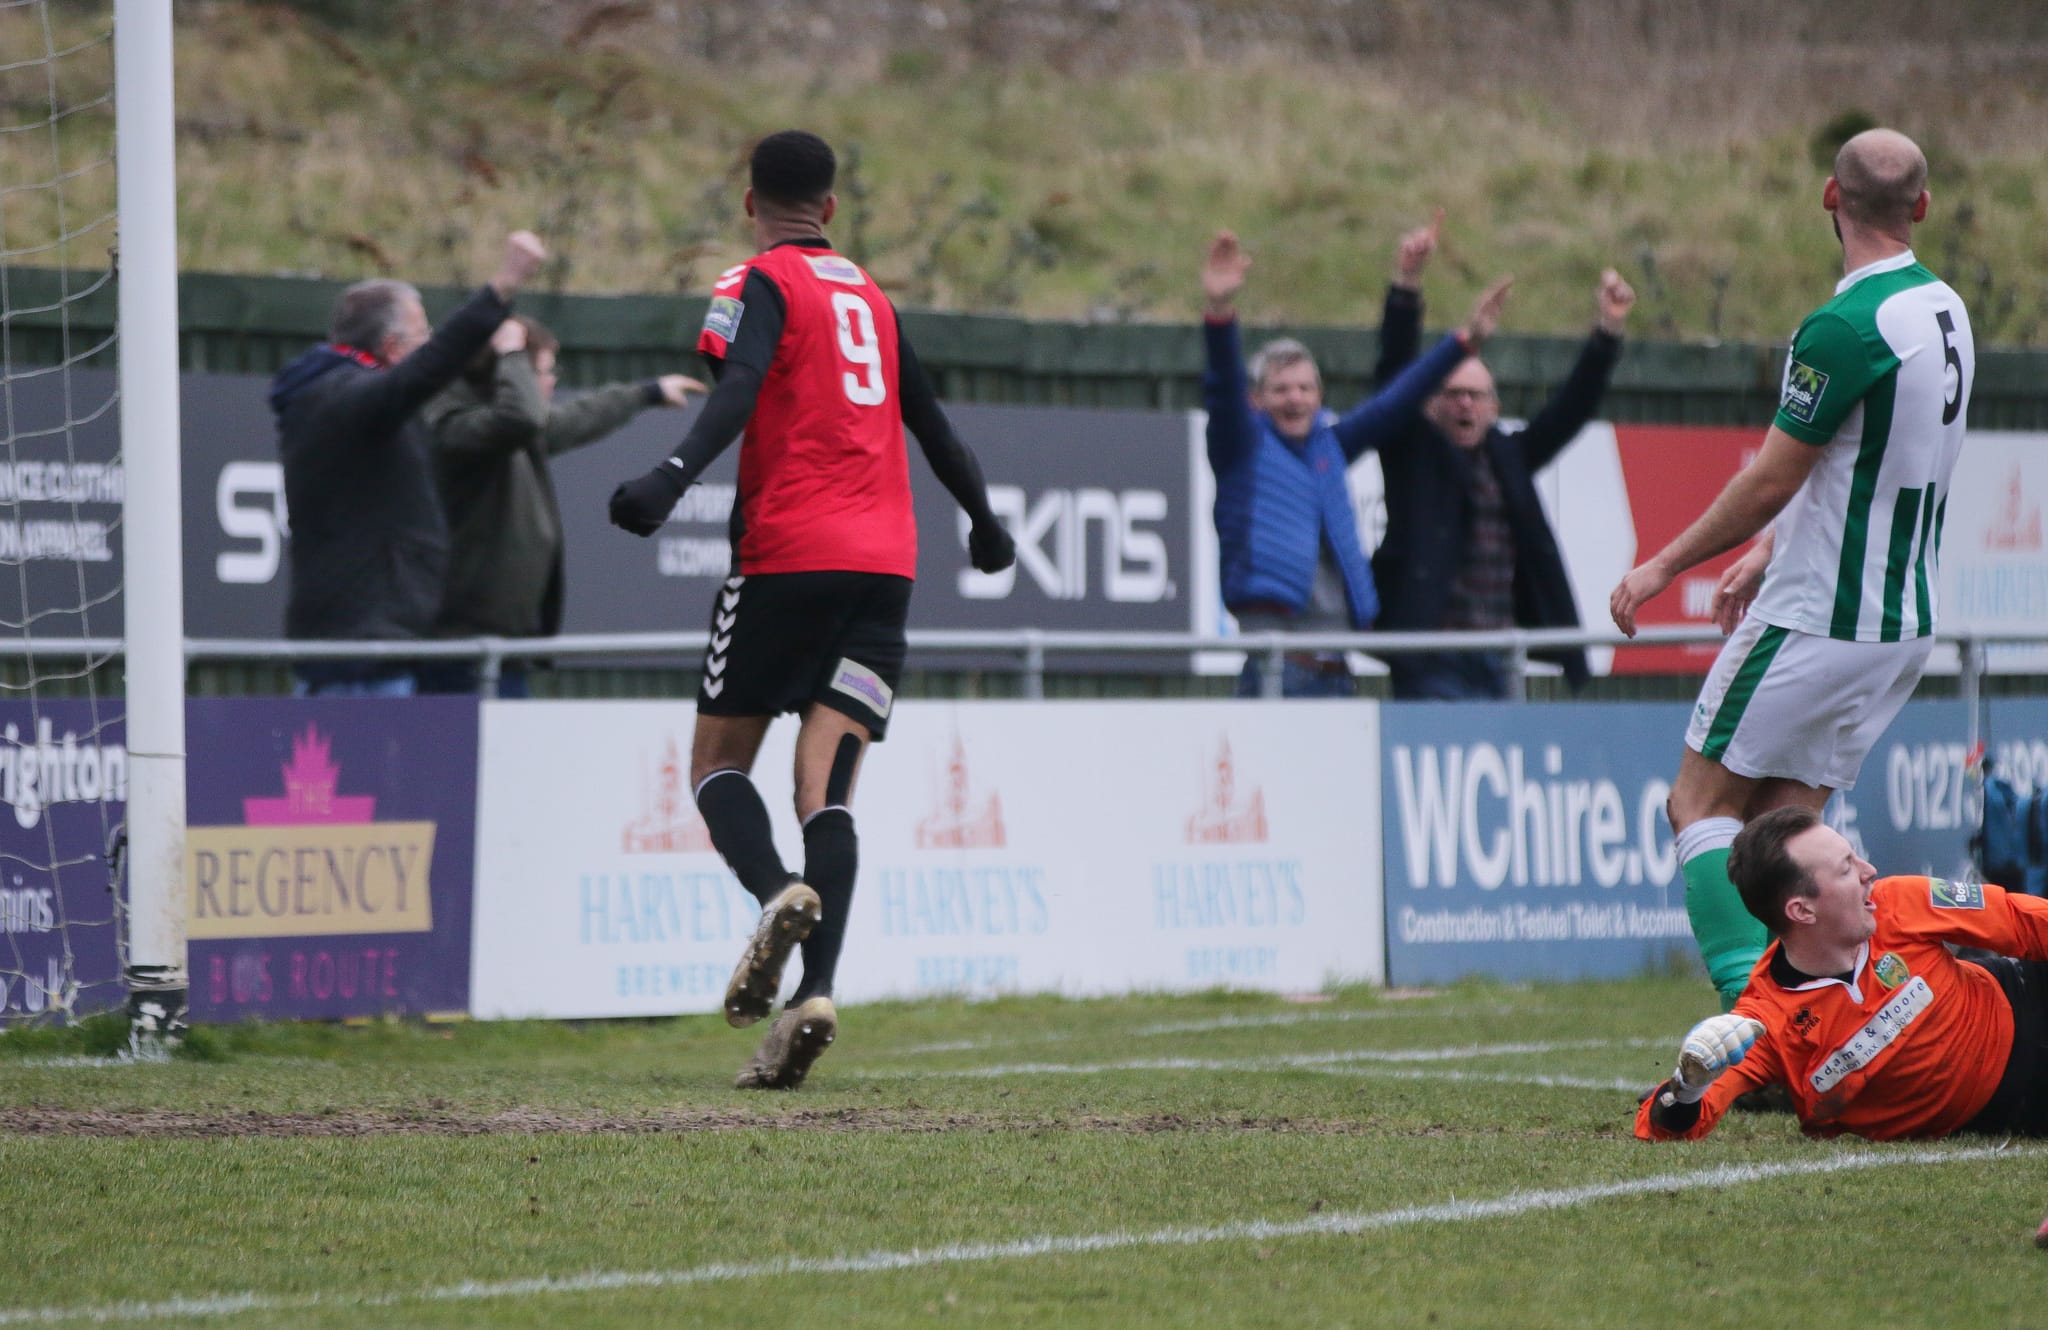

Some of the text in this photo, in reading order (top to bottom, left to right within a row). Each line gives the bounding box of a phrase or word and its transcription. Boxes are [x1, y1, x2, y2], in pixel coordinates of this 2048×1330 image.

[830, 291, 886, 406] 9
[1935, 310, 1963, 426] 5
[216, 461, 290, 584] S
[1392, 741, 1676, 891] WChire.c
[194, 845, 420, 919] REGENCY
[879, 863, 1050, 936] HARVEY'S
[1152, 857, 1307, 930] HARVEY'S
[1403, 905, 1499, 944] Construction
[1503, 904, 1516, 939] &
[1519, 902, 1571, 940] Festival
[1574, 902, 1614, 939] Toilet
[1615, 902, 1626, 938] &
[210, 948, 399, 1004] BUS ROUTE
[1185, 945, 1279, 978] BREWERY
[1875, 954, 1891, 973] VCD
[1814, 982, 1925, 1085] Adams & Moore
[1863, 1043, 1879, 1058] TAX
[1882, 1010, 1914, 1041] ADVISORY
